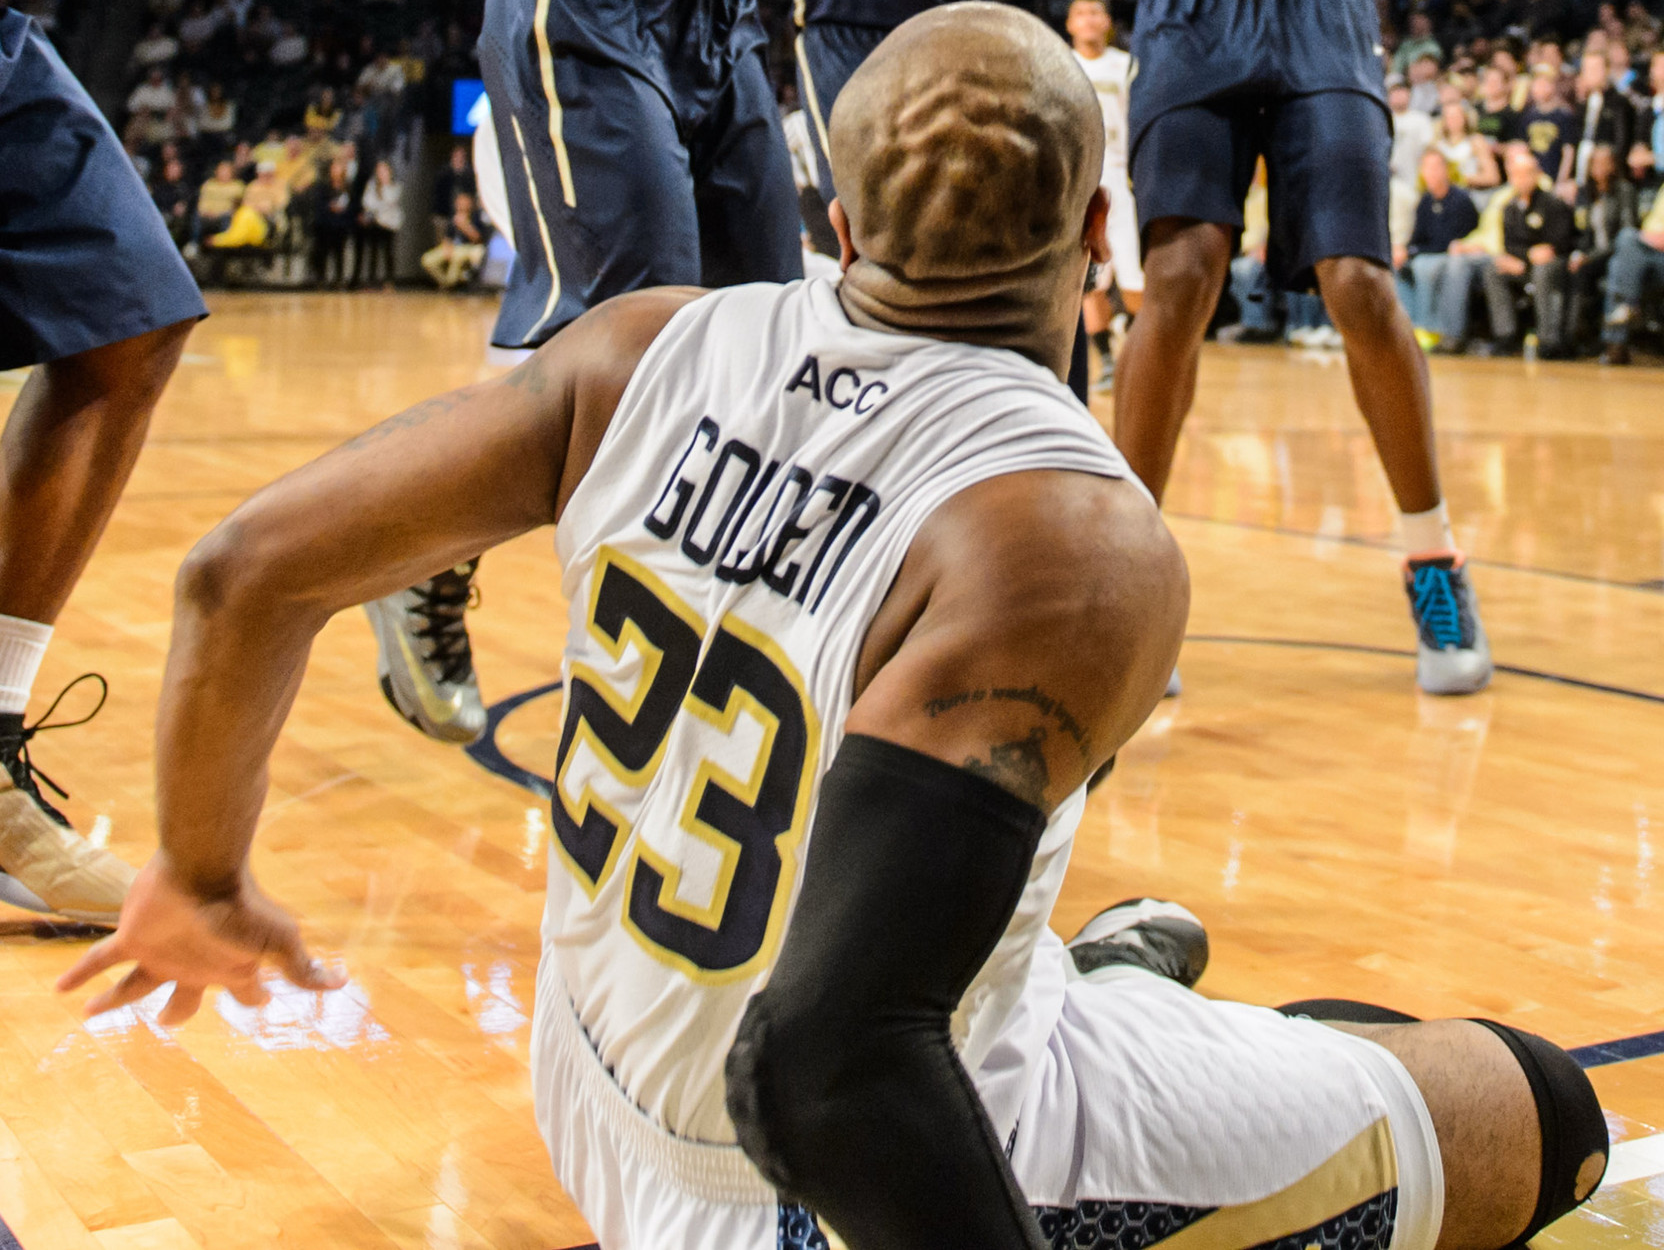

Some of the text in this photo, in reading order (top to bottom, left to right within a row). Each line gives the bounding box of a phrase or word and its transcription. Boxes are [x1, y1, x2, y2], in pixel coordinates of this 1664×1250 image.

[785, 354, 888, 415] ACC
[643, 415, 881, 615] GOLDEN
[551, 545, 820, 986] 23
